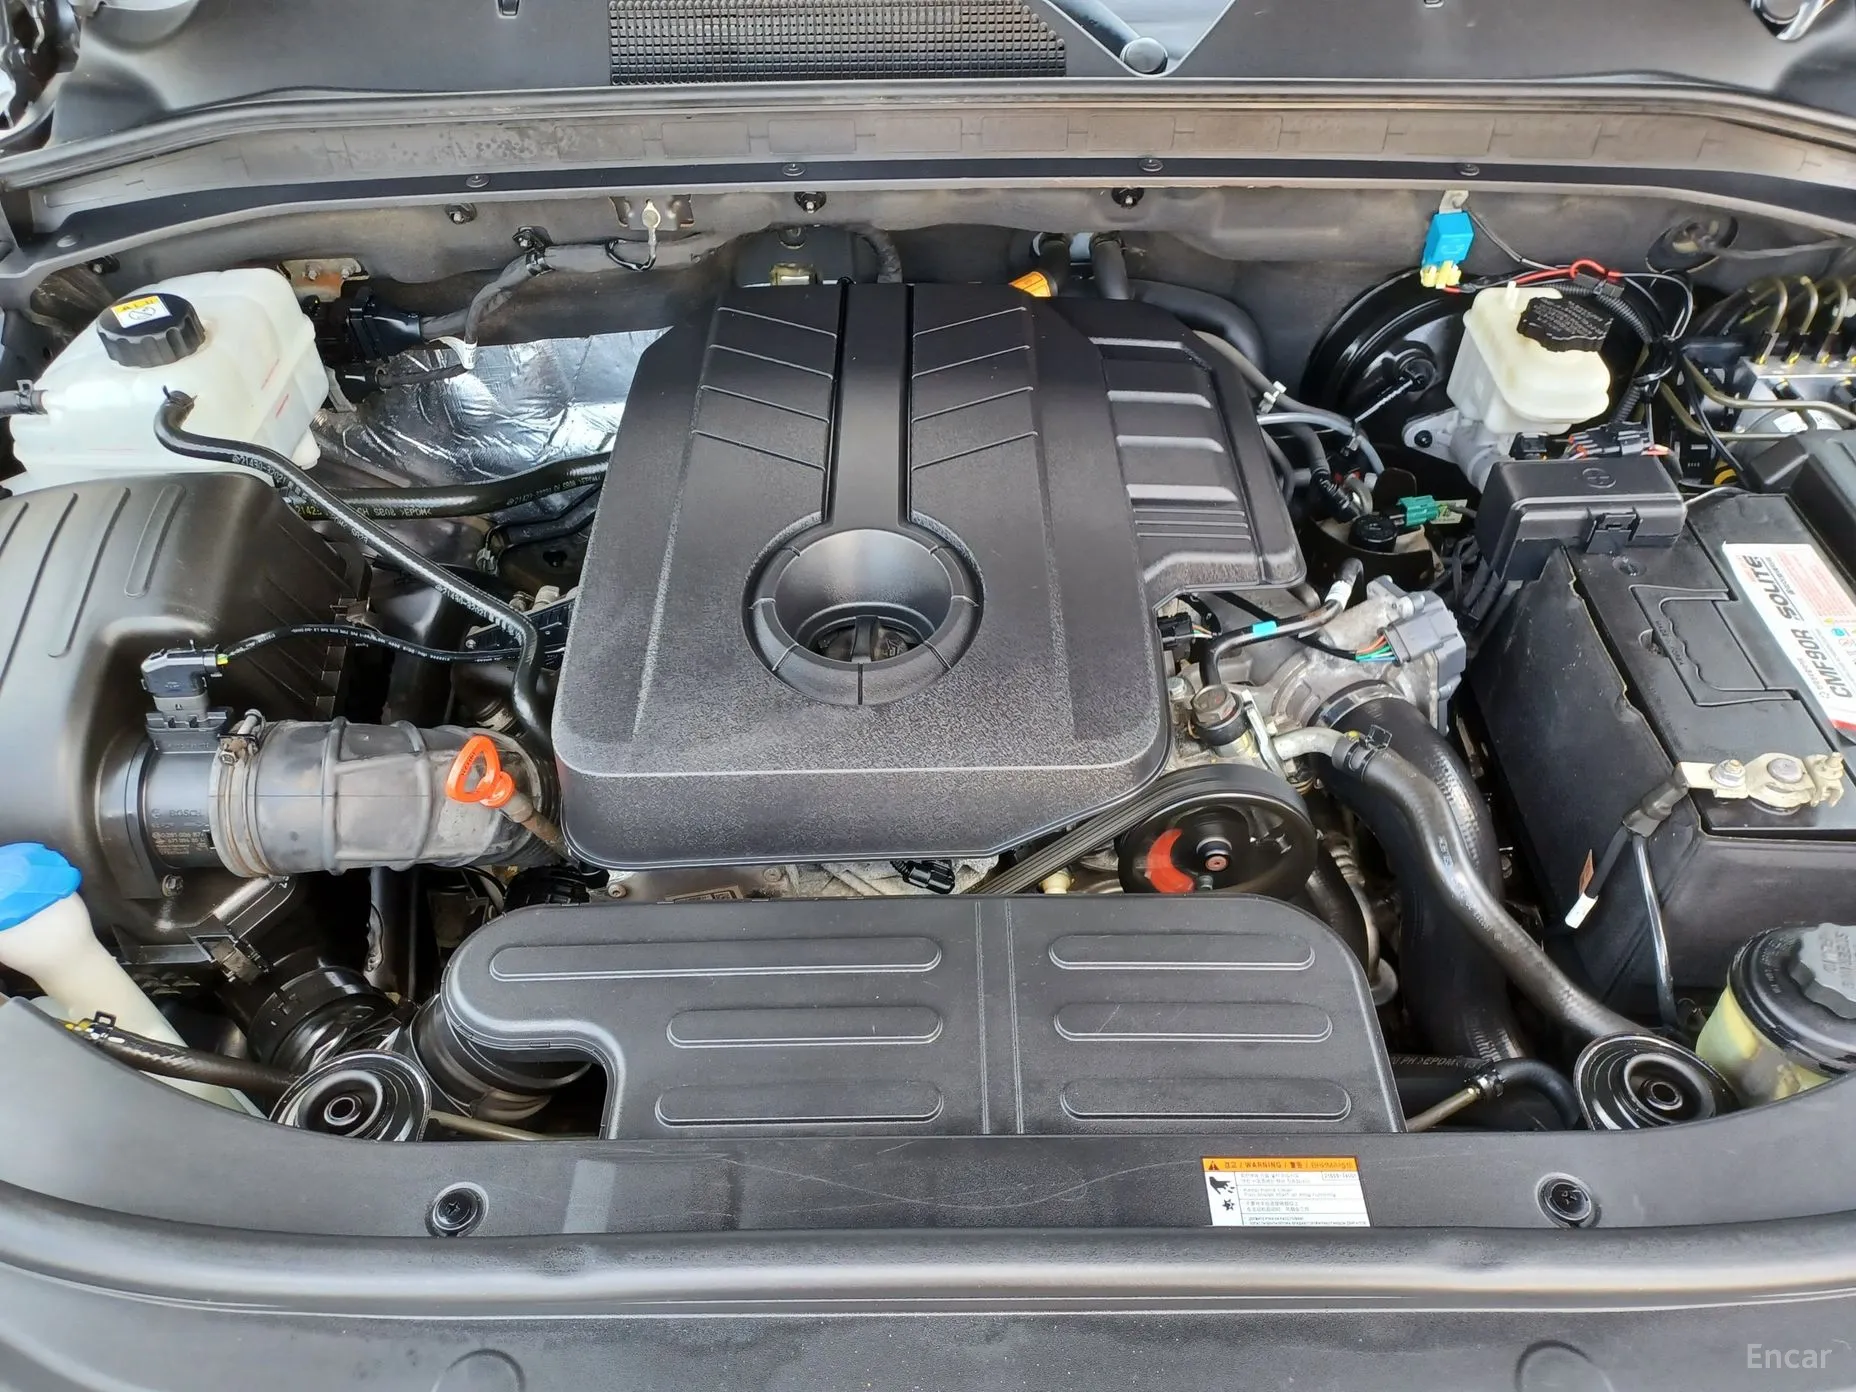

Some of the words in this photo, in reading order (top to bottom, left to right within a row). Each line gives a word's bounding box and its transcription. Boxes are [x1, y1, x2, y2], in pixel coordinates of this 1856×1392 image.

[1743, 555, 1798, 622] SOLITE
[1791, 628, 1852, 698] CMF90R
[1245, 1161, 1282, 1169] WARNING
